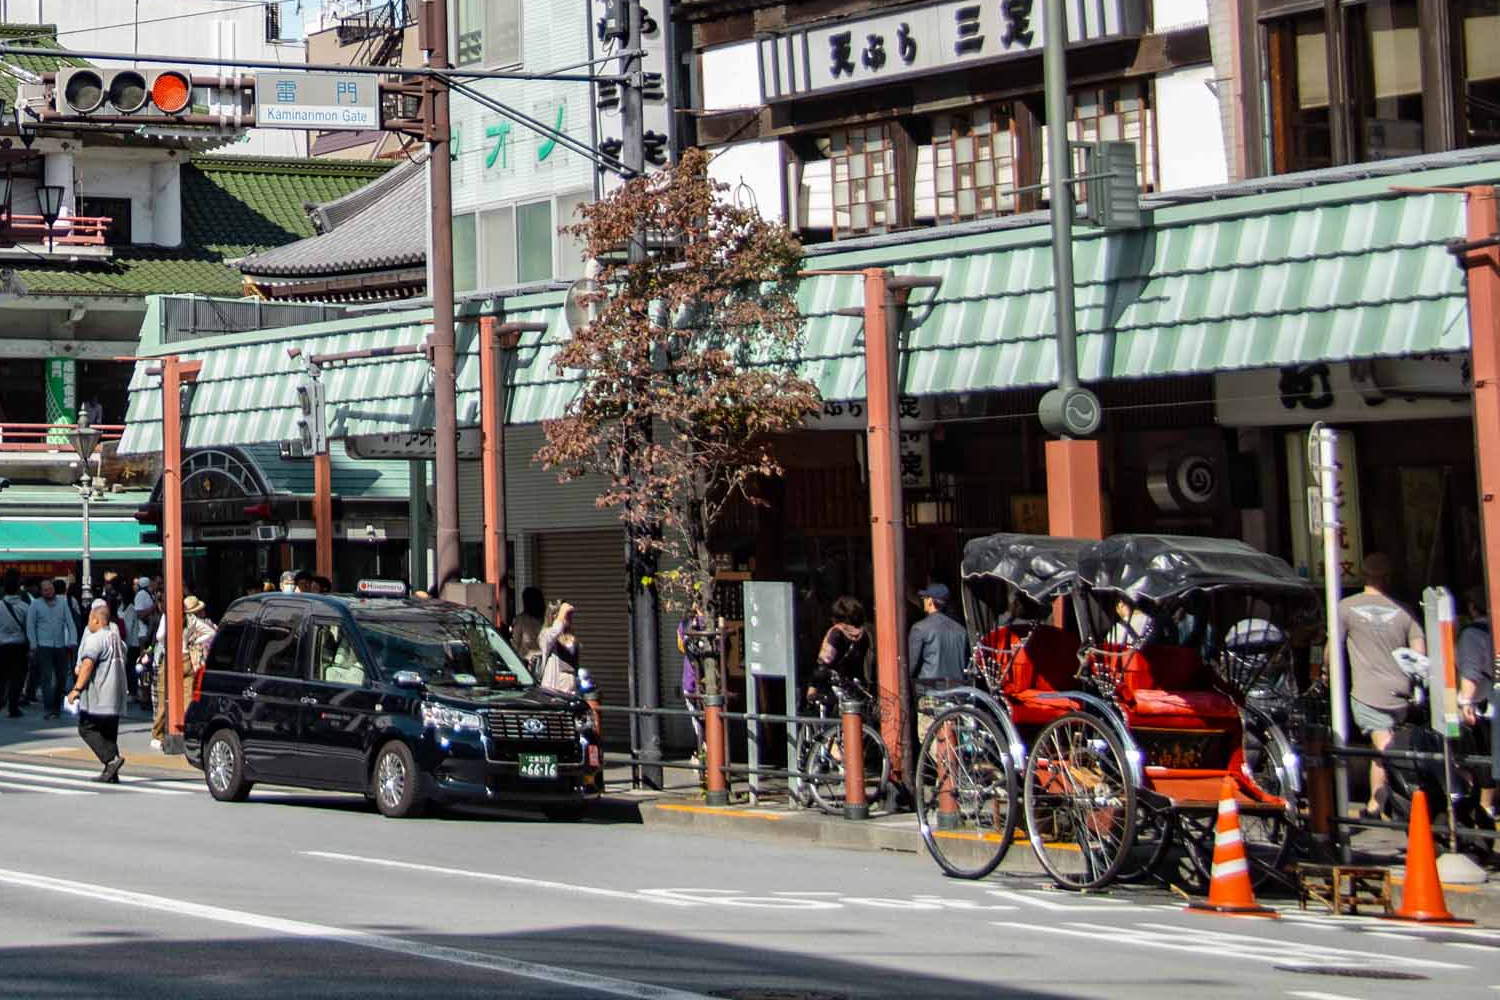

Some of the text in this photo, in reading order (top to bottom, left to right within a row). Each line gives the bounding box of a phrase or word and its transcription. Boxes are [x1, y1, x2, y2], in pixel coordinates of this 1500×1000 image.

[827, 22, 918, 79] 天ぷら
[275, 80, 358, 104] 雷門
[267, 107, 367, 122] Kaminarimon Gate
